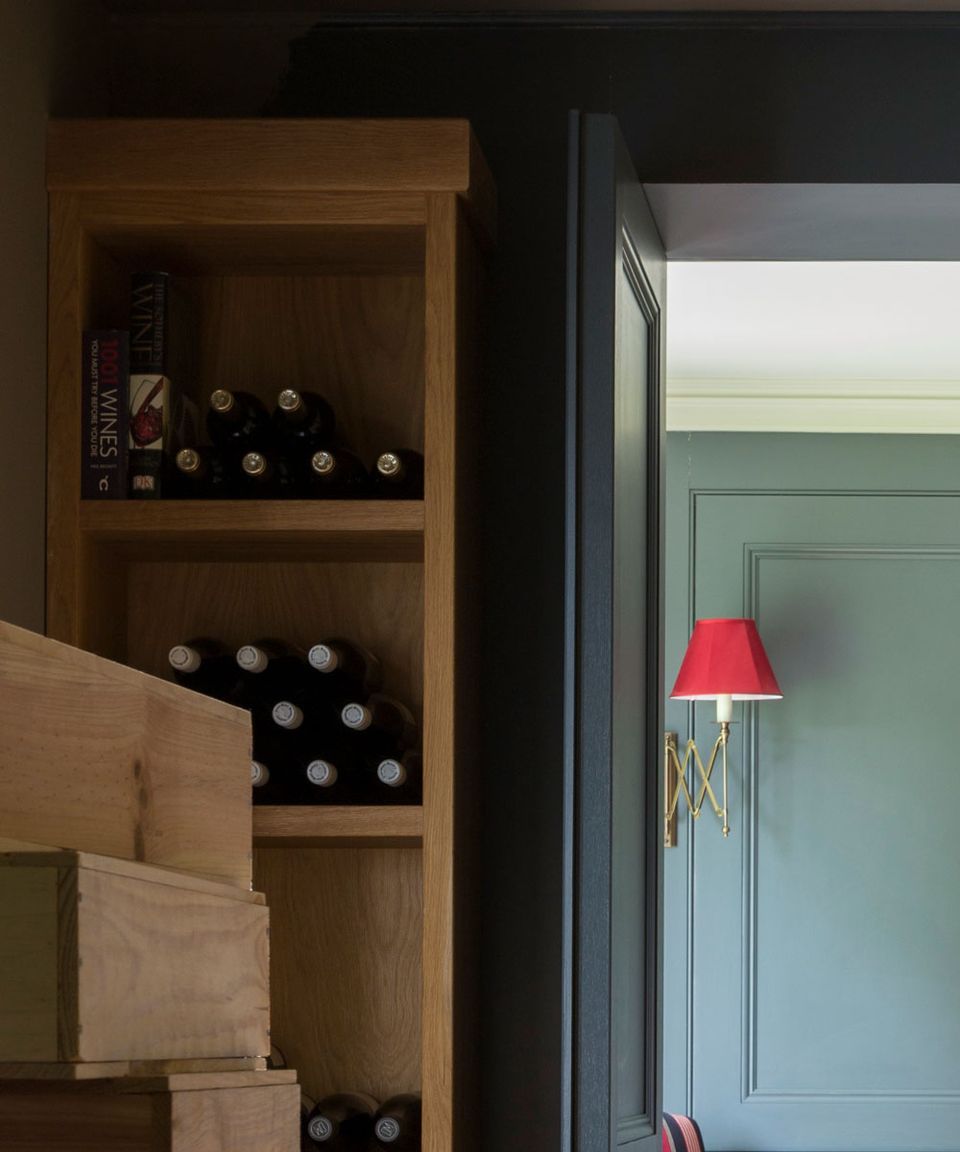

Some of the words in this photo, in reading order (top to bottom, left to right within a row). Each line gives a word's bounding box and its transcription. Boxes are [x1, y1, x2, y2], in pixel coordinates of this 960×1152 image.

[100, 338, 119, 385] 1001
[90, 396, 98, 424] BEFORE
[99, 388, 118, 457] WINES
[90, 426, 98, 443] YOU
[90, 444, 98, 458] DIE
